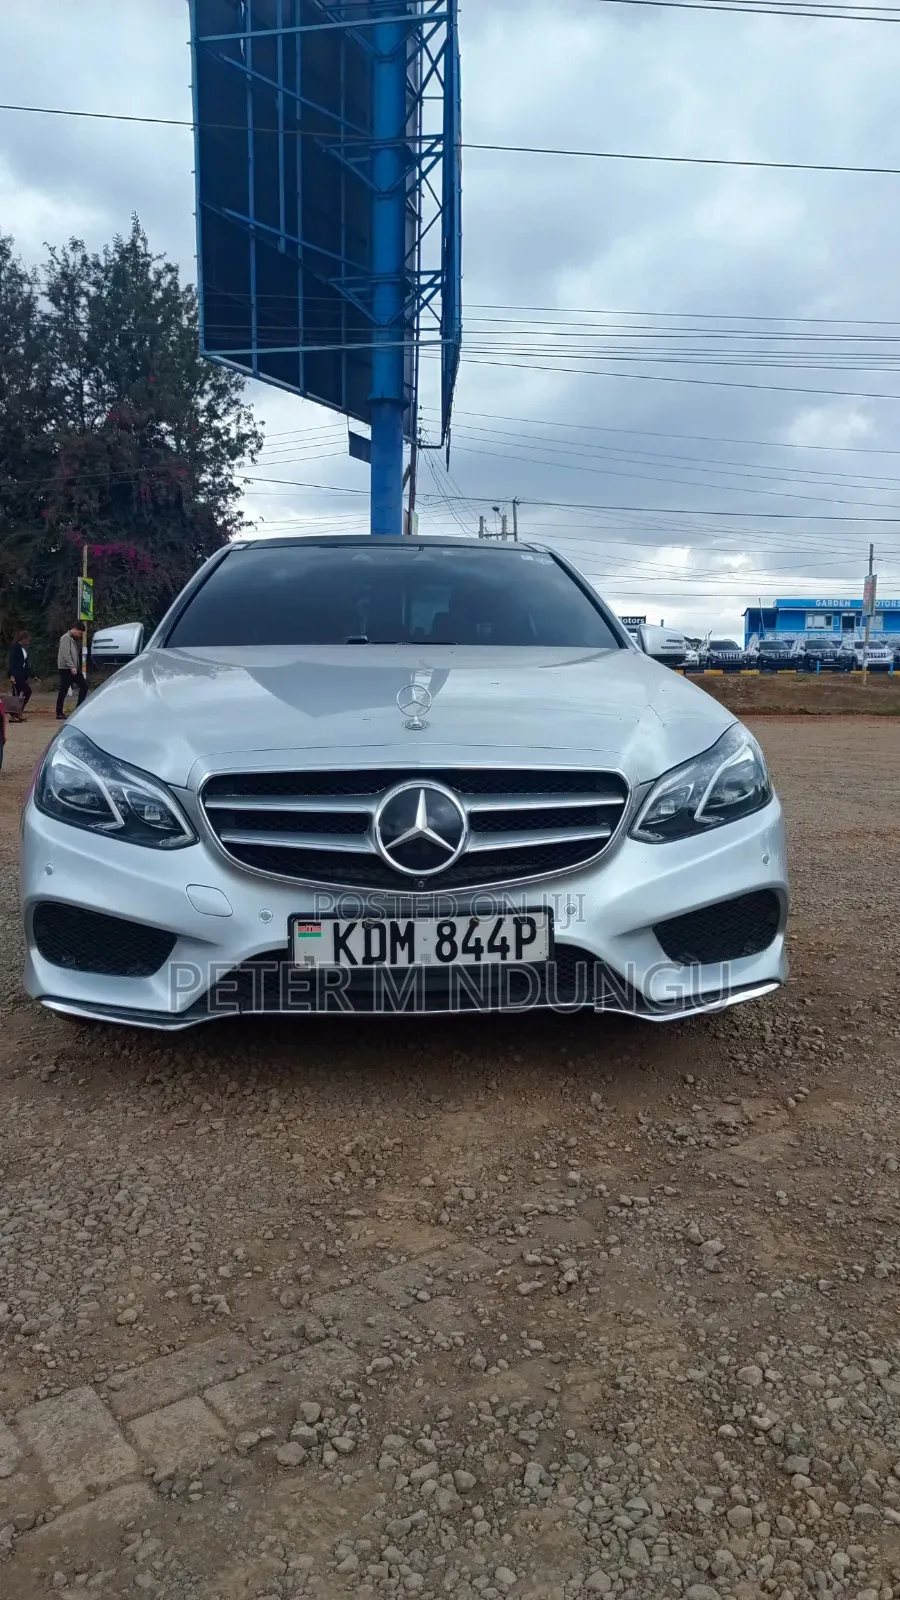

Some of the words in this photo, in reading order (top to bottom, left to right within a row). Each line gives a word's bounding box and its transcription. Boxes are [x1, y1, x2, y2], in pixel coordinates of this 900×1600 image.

[815, 599, 851, 607] GARDEN
[333, 920, 415, 966] KDM
[435, 915, 538, 963] 844P
